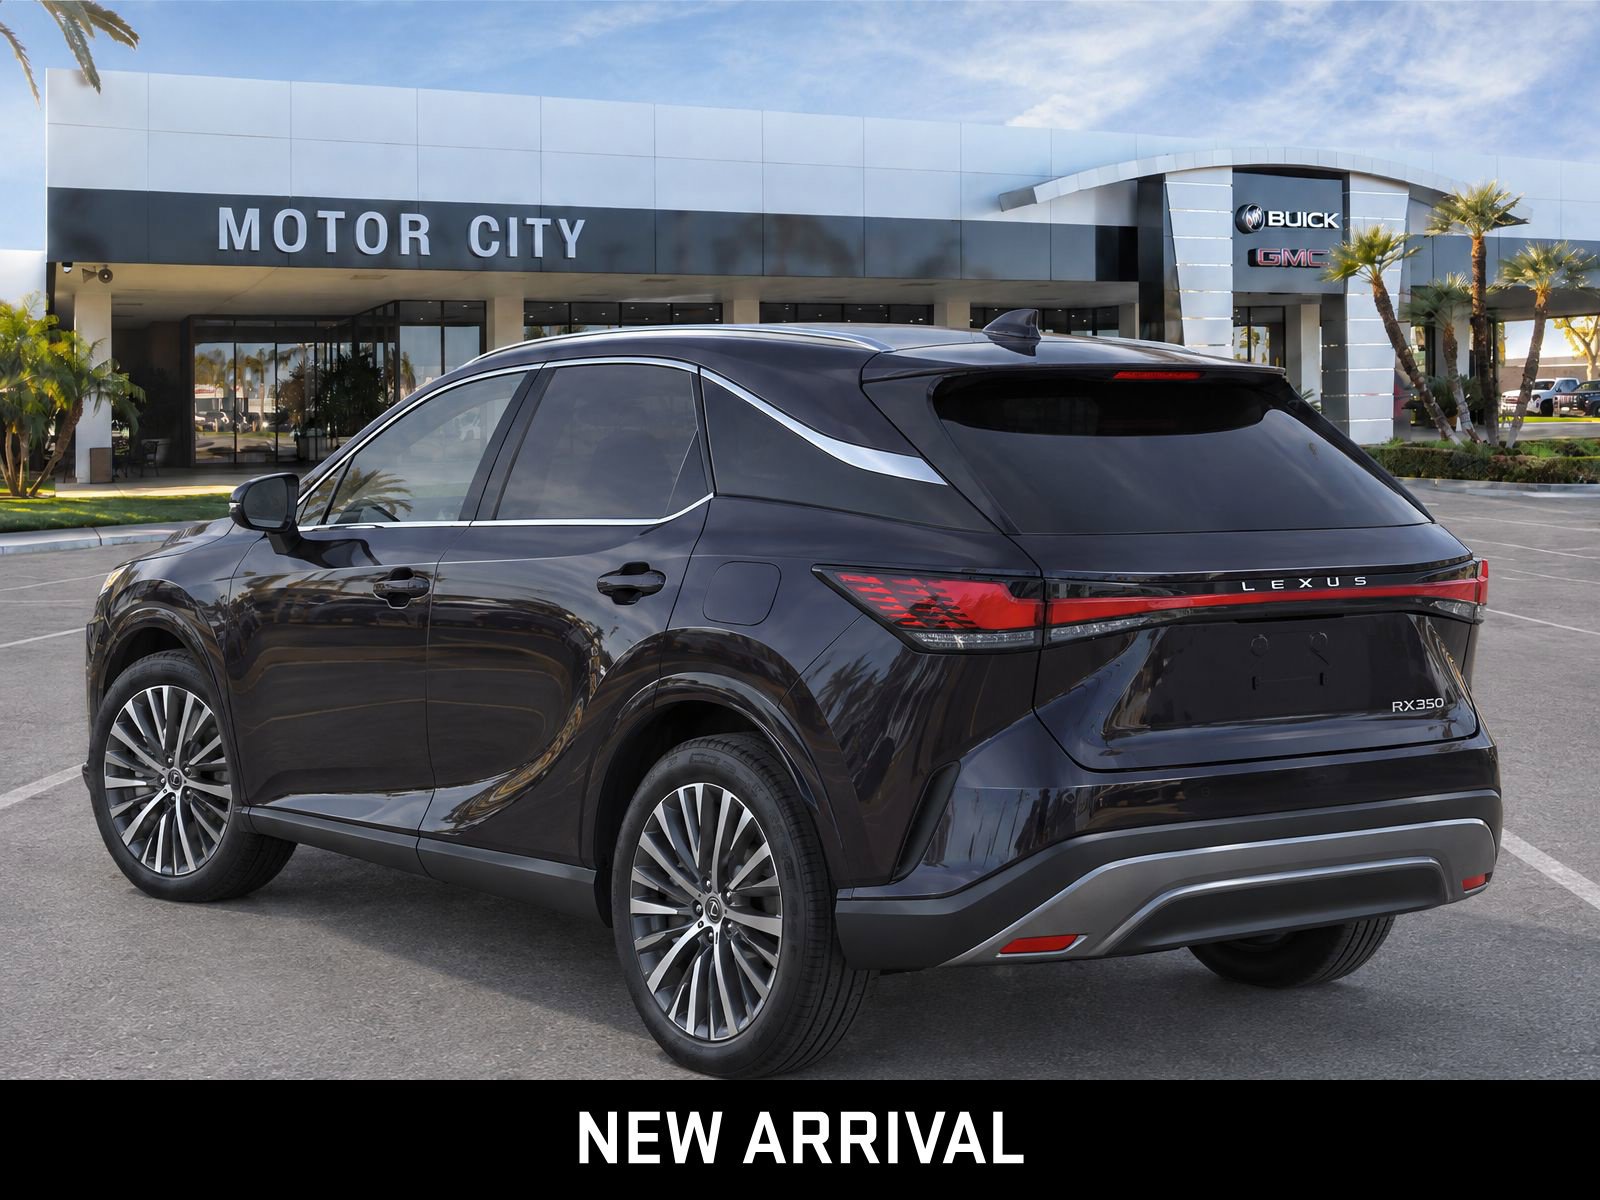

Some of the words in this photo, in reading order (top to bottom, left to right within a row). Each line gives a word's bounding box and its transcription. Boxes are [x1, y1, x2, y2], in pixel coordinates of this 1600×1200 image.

[1267, 210, 1340, 229] BUICK
[218, 207, 430, 256] MOTOR
[467, 214, 585, 259] CITY
[1257, 247, 1330, 267] GMC
[1241, 576, 1367, 591] LEXUS
[1392, 697, 1444, 713] RX350
